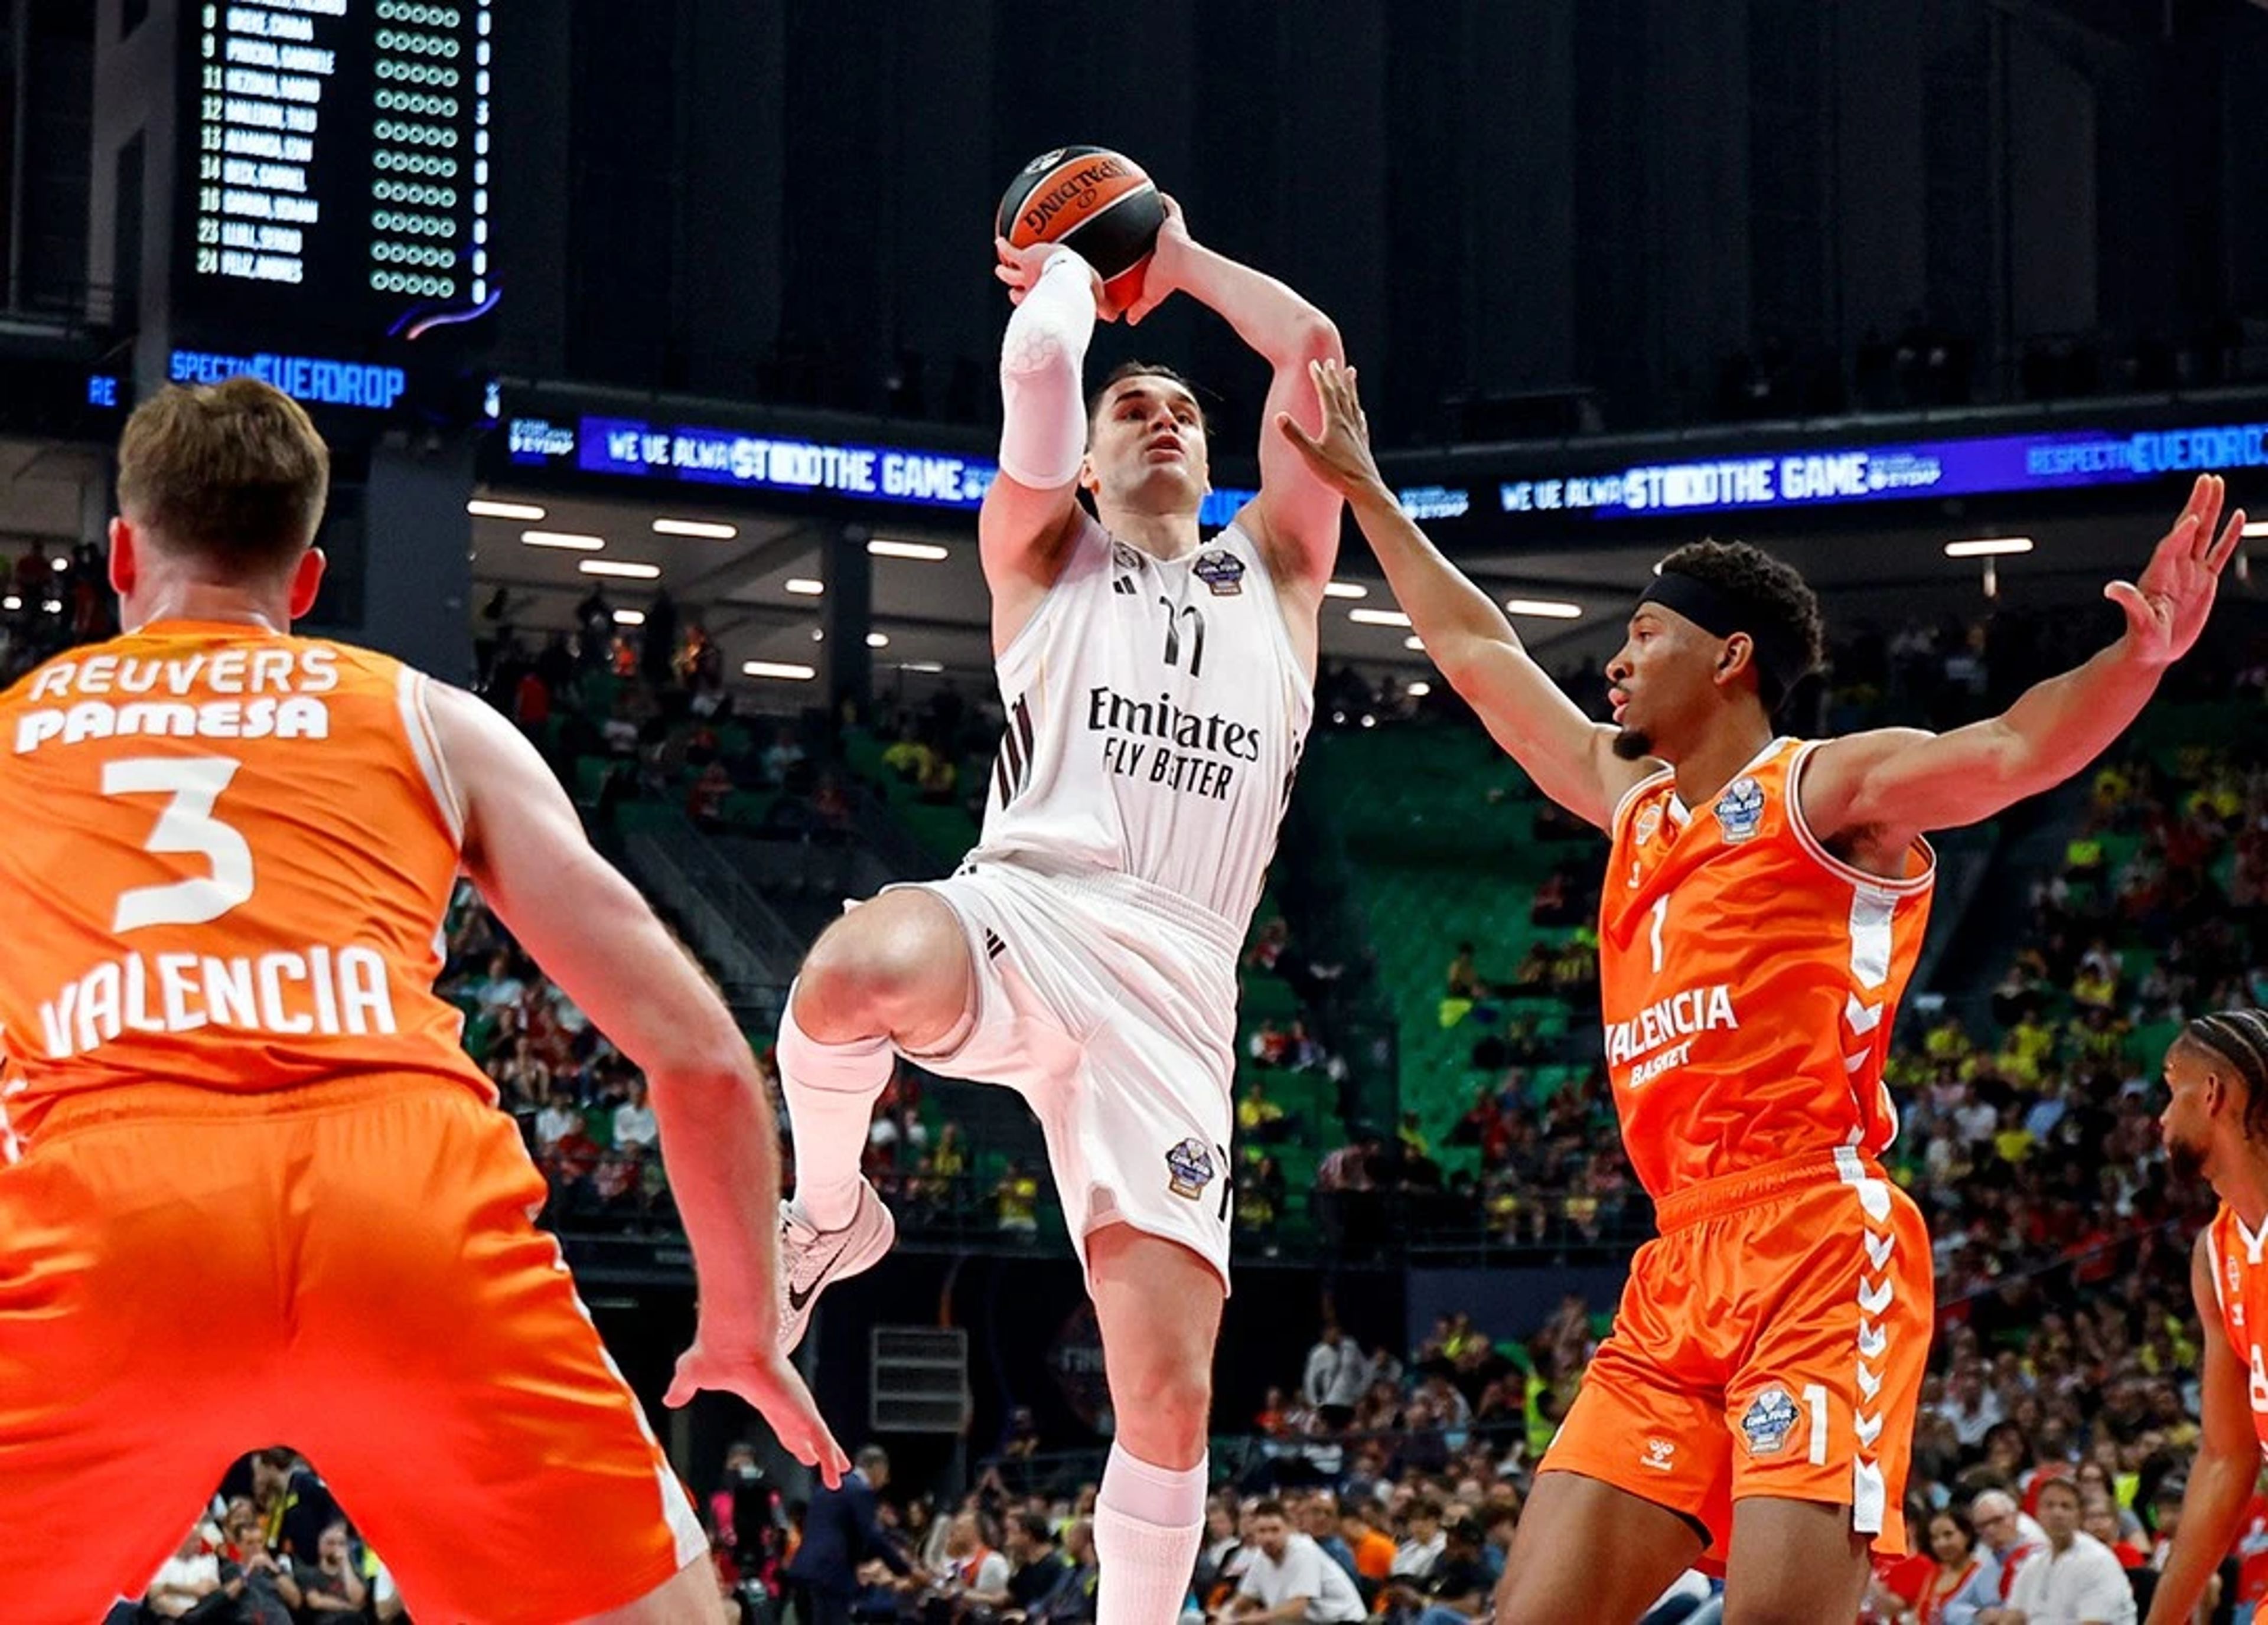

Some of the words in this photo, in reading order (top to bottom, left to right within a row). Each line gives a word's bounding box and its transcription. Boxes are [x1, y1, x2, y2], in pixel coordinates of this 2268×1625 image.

[201, 94, 223, 121] 12
[882, 453, 964, 501] GAME
[1780, 452, 1869, 500] GAME
[28, 650, 340, 701] REUVERS
[15, 696, 329, 754] PAMESA
[1088, 686, 1260, 762] Emirates
[1102, 736, 1146, 777] FLY
[101, 756, 255, 934] 3
[1650, 893, 1671, 974] 1
[39, 945, 397, 1059] VALENCIA
[1802, 1383, 1828, 1466] 1
